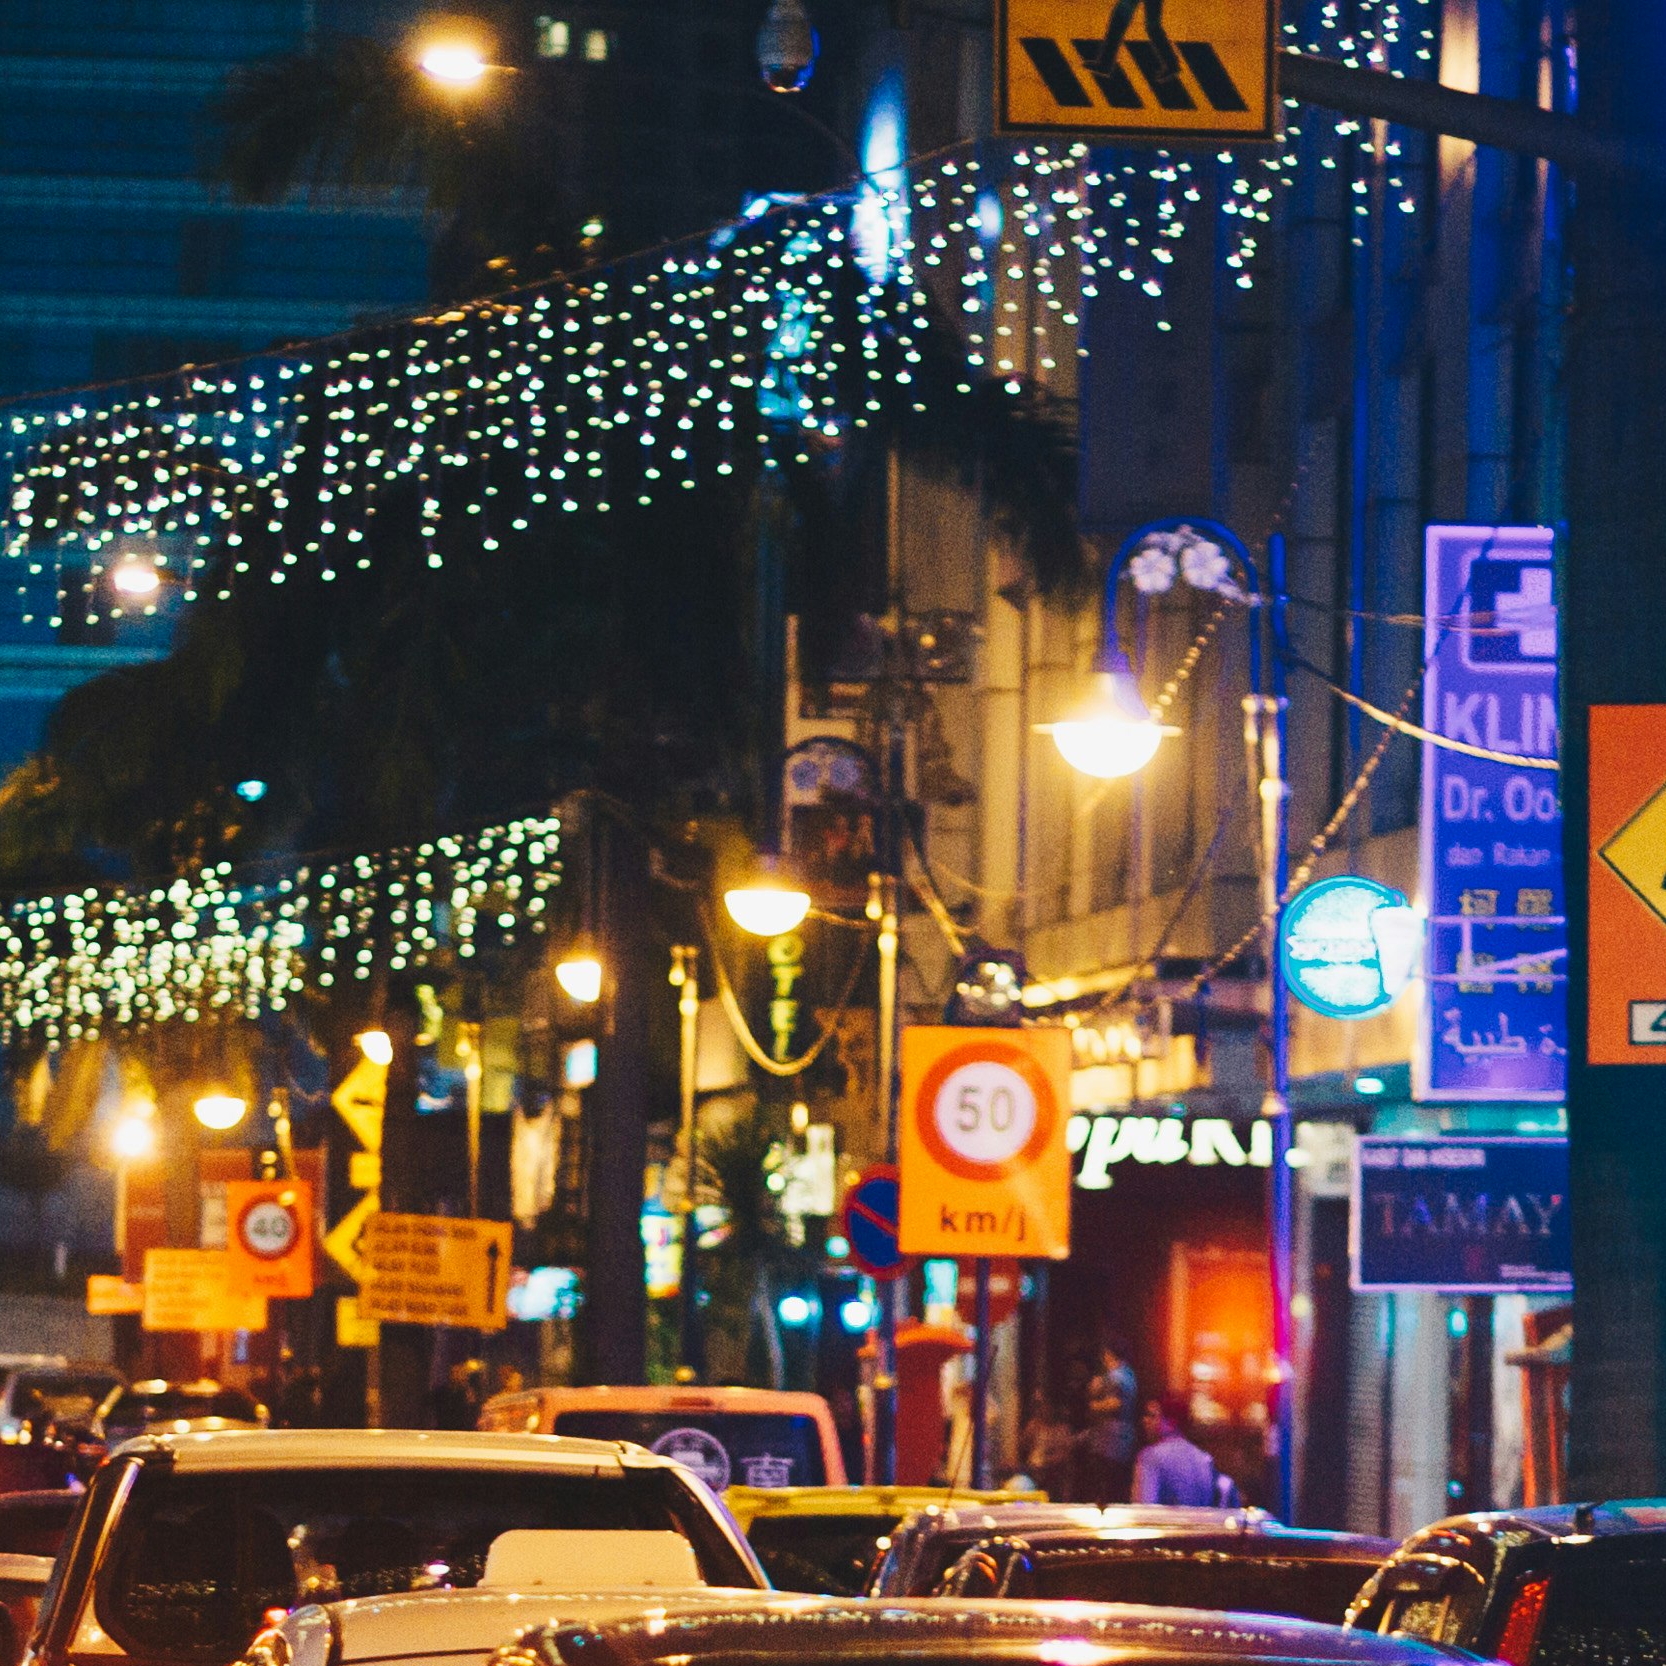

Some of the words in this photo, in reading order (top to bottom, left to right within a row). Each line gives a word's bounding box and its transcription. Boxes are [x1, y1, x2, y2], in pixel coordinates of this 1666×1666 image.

[1442, 775, 1495, 823] Dr.
[956, 1085, 1015, 1134] 50
[253, 1215, 290, 1239] 40
[939, 1205, 1028, 1242] km/j
